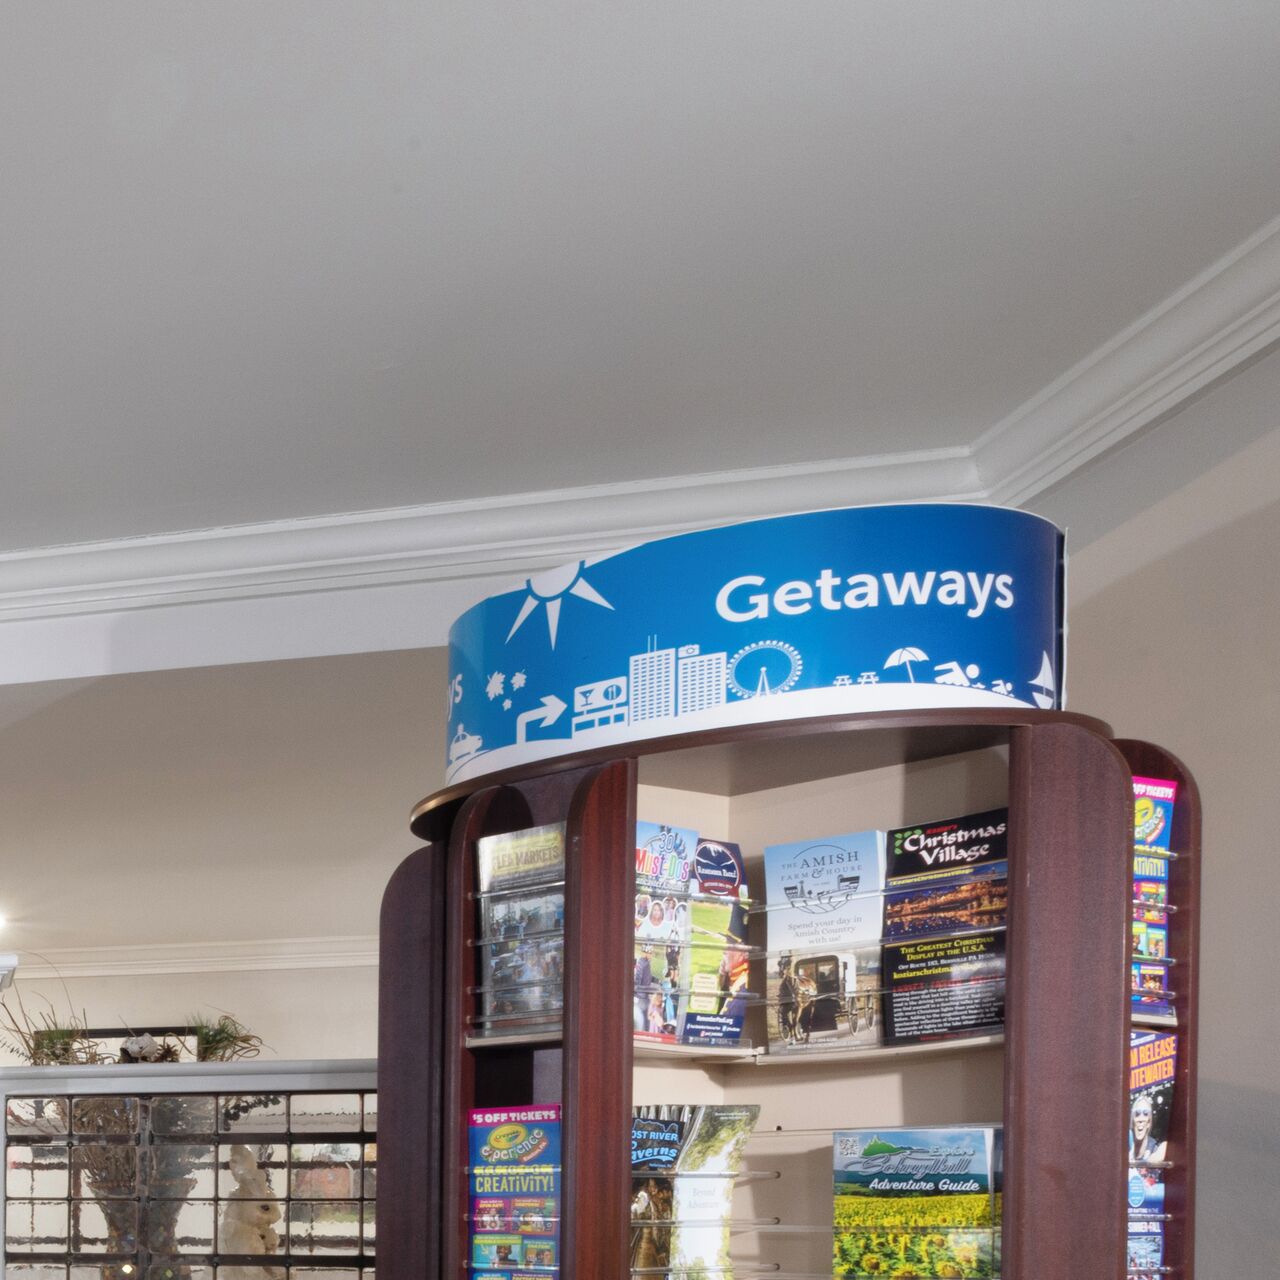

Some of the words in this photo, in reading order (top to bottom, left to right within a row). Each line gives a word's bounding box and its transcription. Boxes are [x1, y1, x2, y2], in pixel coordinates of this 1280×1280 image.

[715, 569, 1014, 623] Getaways
[659, 832, 674, 853] 30
[904, 823, 1007, 852] Christmas
[800, 851, 858, 869] AMISH
[919, 844, 990, 865] Village
[812, 868, 824, 879] &
[917, 942, 952, 952] GREATEST
[954, 937, 994, 946] CHRISTMAS
[907, 952, 935, 961] DISPLAY
[1140, 1036, 1176, 1065] RELEASE
[484, 1113, 508, 1122] OFF
[650, 1131, 679, 1142] RIVER
[869, 1178, 935, 1191] Adventure
[938, 1178, 980, 1191] Guide
